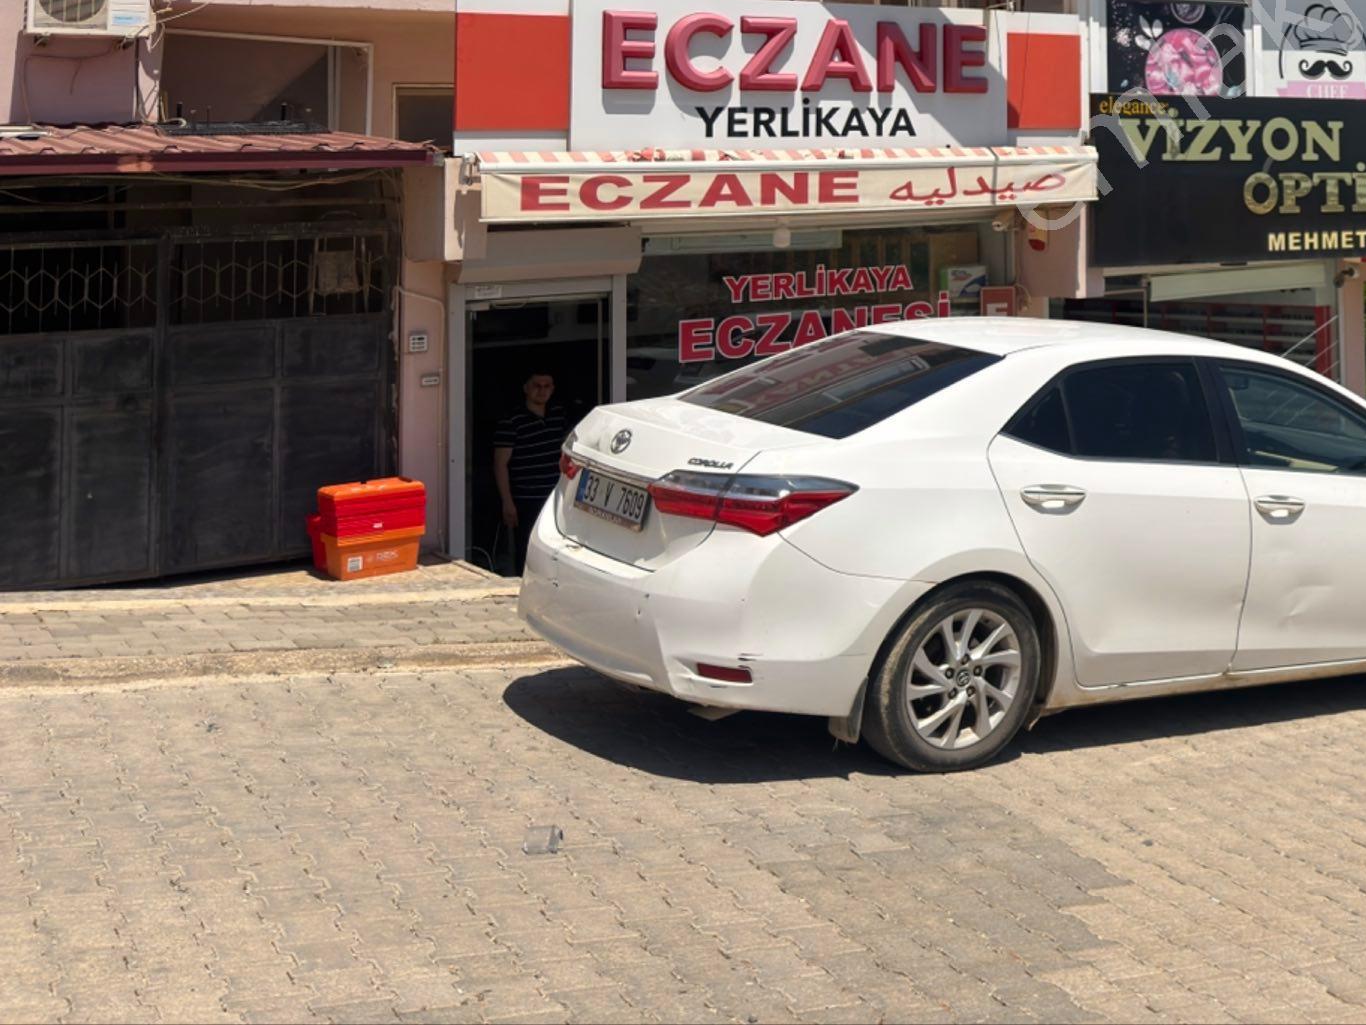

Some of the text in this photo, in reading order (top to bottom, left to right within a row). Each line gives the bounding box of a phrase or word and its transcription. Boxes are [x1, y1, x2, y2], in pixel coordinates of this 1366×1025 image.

[602, 9, 988, 93] ECZANE
[695, 97, 917, 137] YERLİKAYA
[1119, 107, 1344, 162] VİZYON
[520, 171, 859, 211] ECZANE
[723, 264, 913, 304] YERLİKAYA
[584, 477, 599, 502] 33
[604, 482, 614, 507] V
[616, 487, 645, 519] 7609
